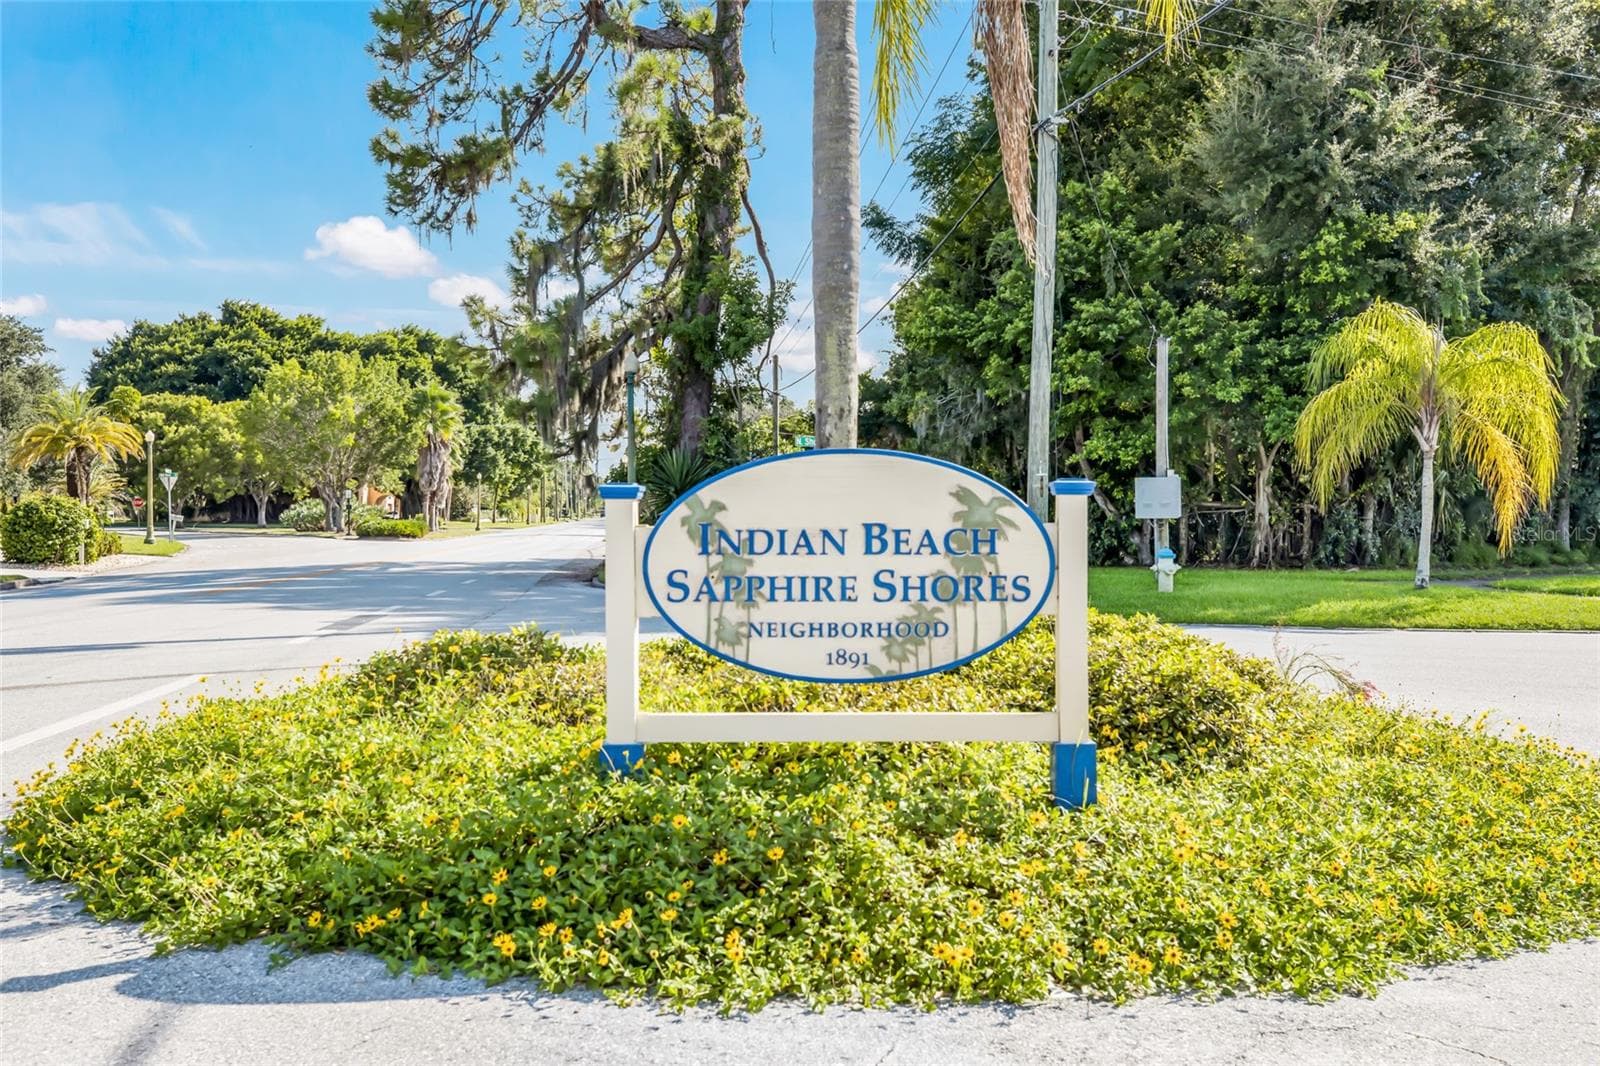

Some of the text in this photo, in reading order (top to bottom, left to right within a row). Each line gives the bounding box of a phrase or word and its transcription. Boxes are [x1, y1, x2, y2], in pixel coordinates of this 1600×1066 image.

[697, 521, 999, 557] INDIAN BEACH
[666, 568, 1031, 604] SAPPHIRE SHORES
[747, 621, 950, 639] NEIGHBORHOOD
[825, 649, 870, 669] 1891
